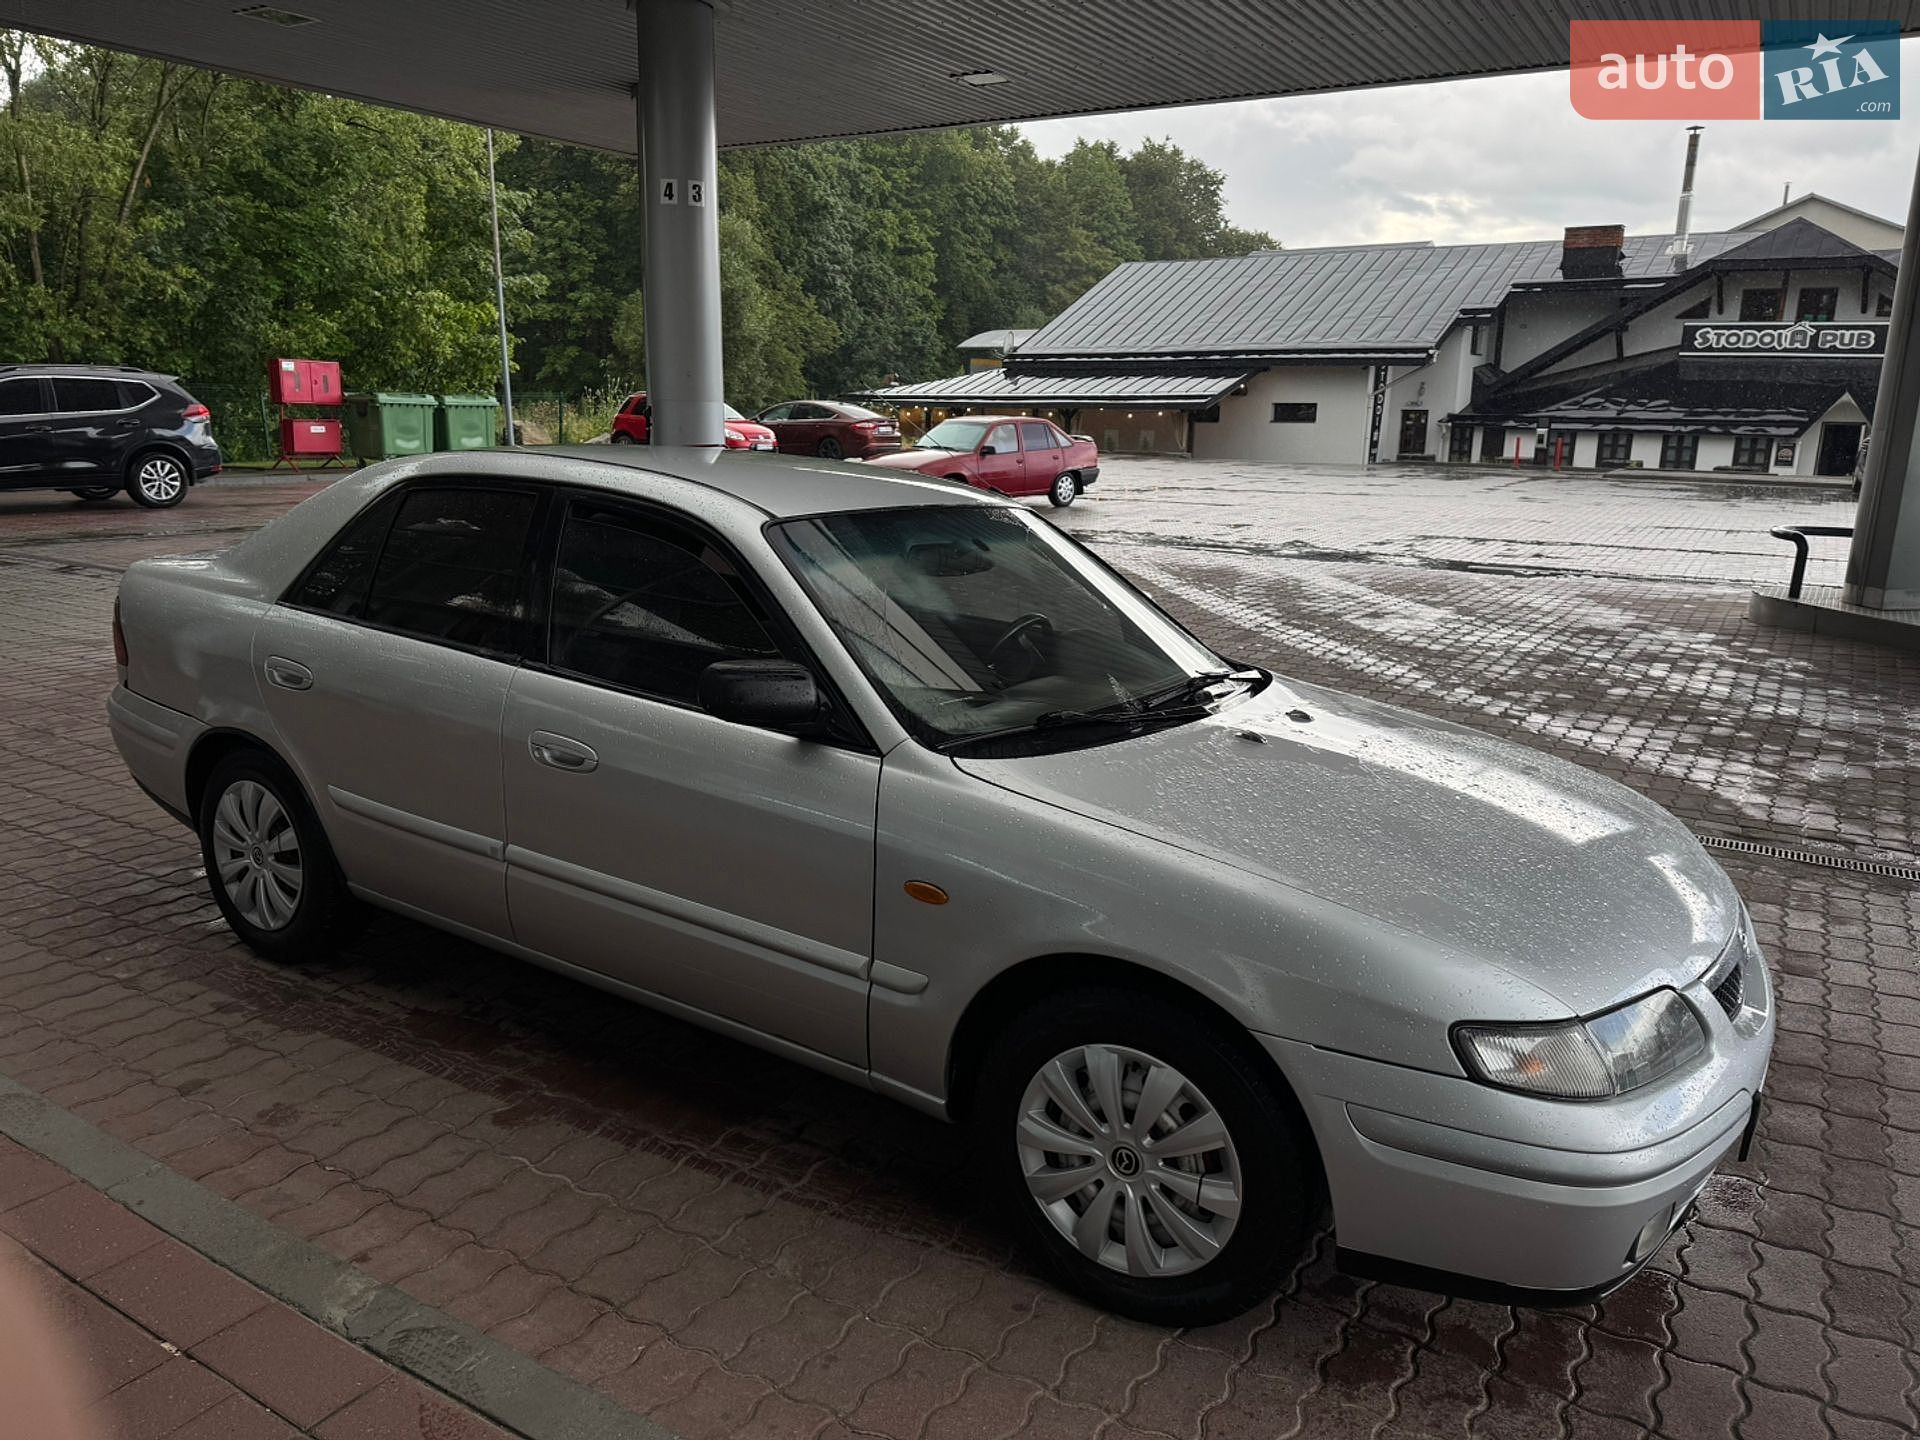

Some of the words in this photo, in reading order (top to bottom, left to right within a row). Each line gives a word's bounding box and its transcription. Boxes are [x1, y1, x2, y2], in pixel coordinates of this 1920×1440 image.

[663, 182, 675, 201] 4
[692, 184, 703, 203] 3
[1818, 329, 1876, 350] PUB
